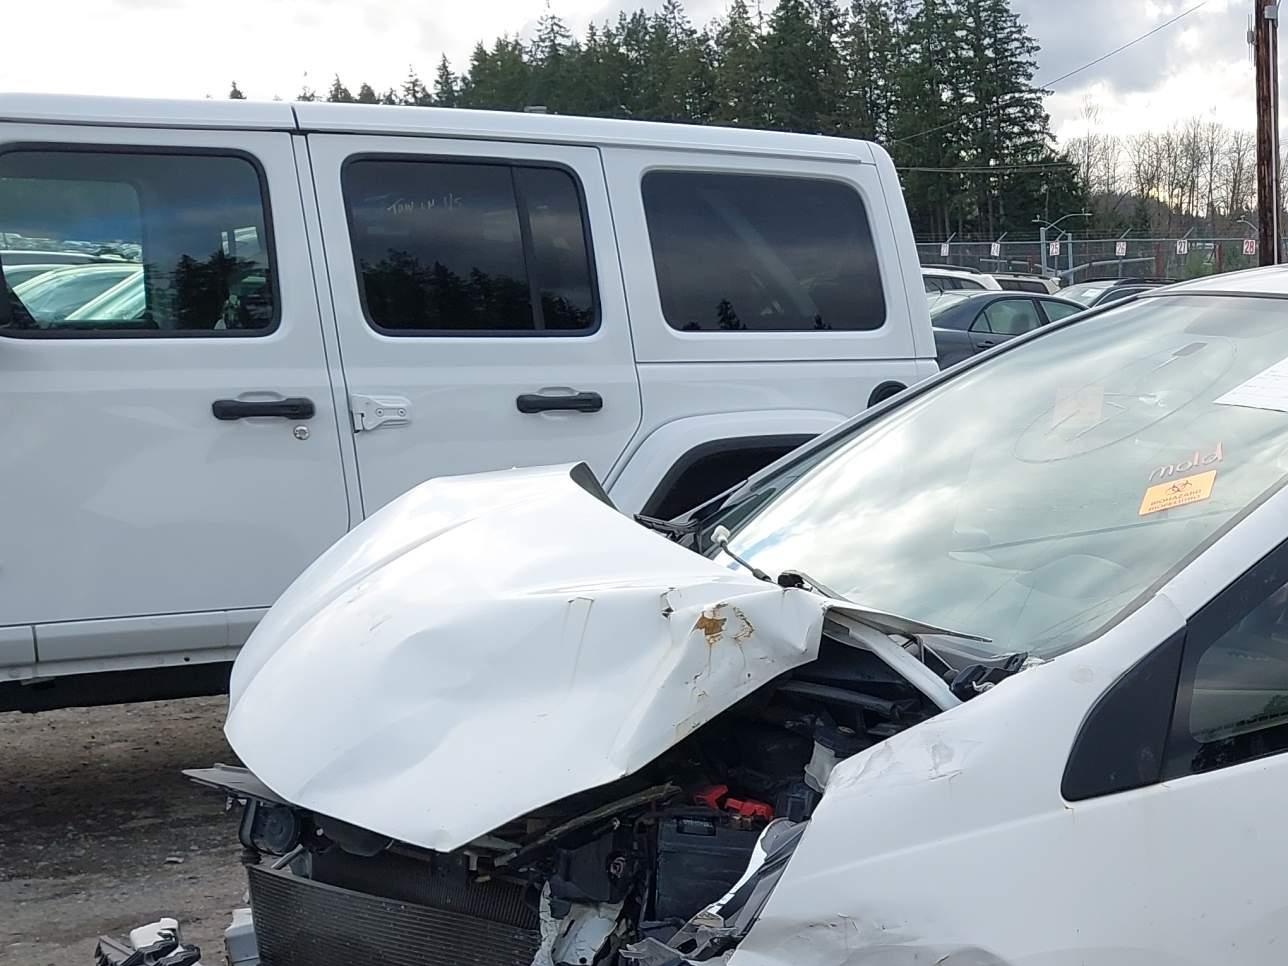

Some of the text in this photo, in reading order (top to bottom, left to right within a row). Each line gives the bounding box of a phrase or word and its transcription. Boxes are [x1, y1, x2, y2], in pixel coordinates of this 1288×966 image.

[1050, 242, 1059, 255] 25
[1178, 241, 1186, 253] 27
[1245, 240, 1254, 254] 28
[1149, 439, 1223, 482] mold
